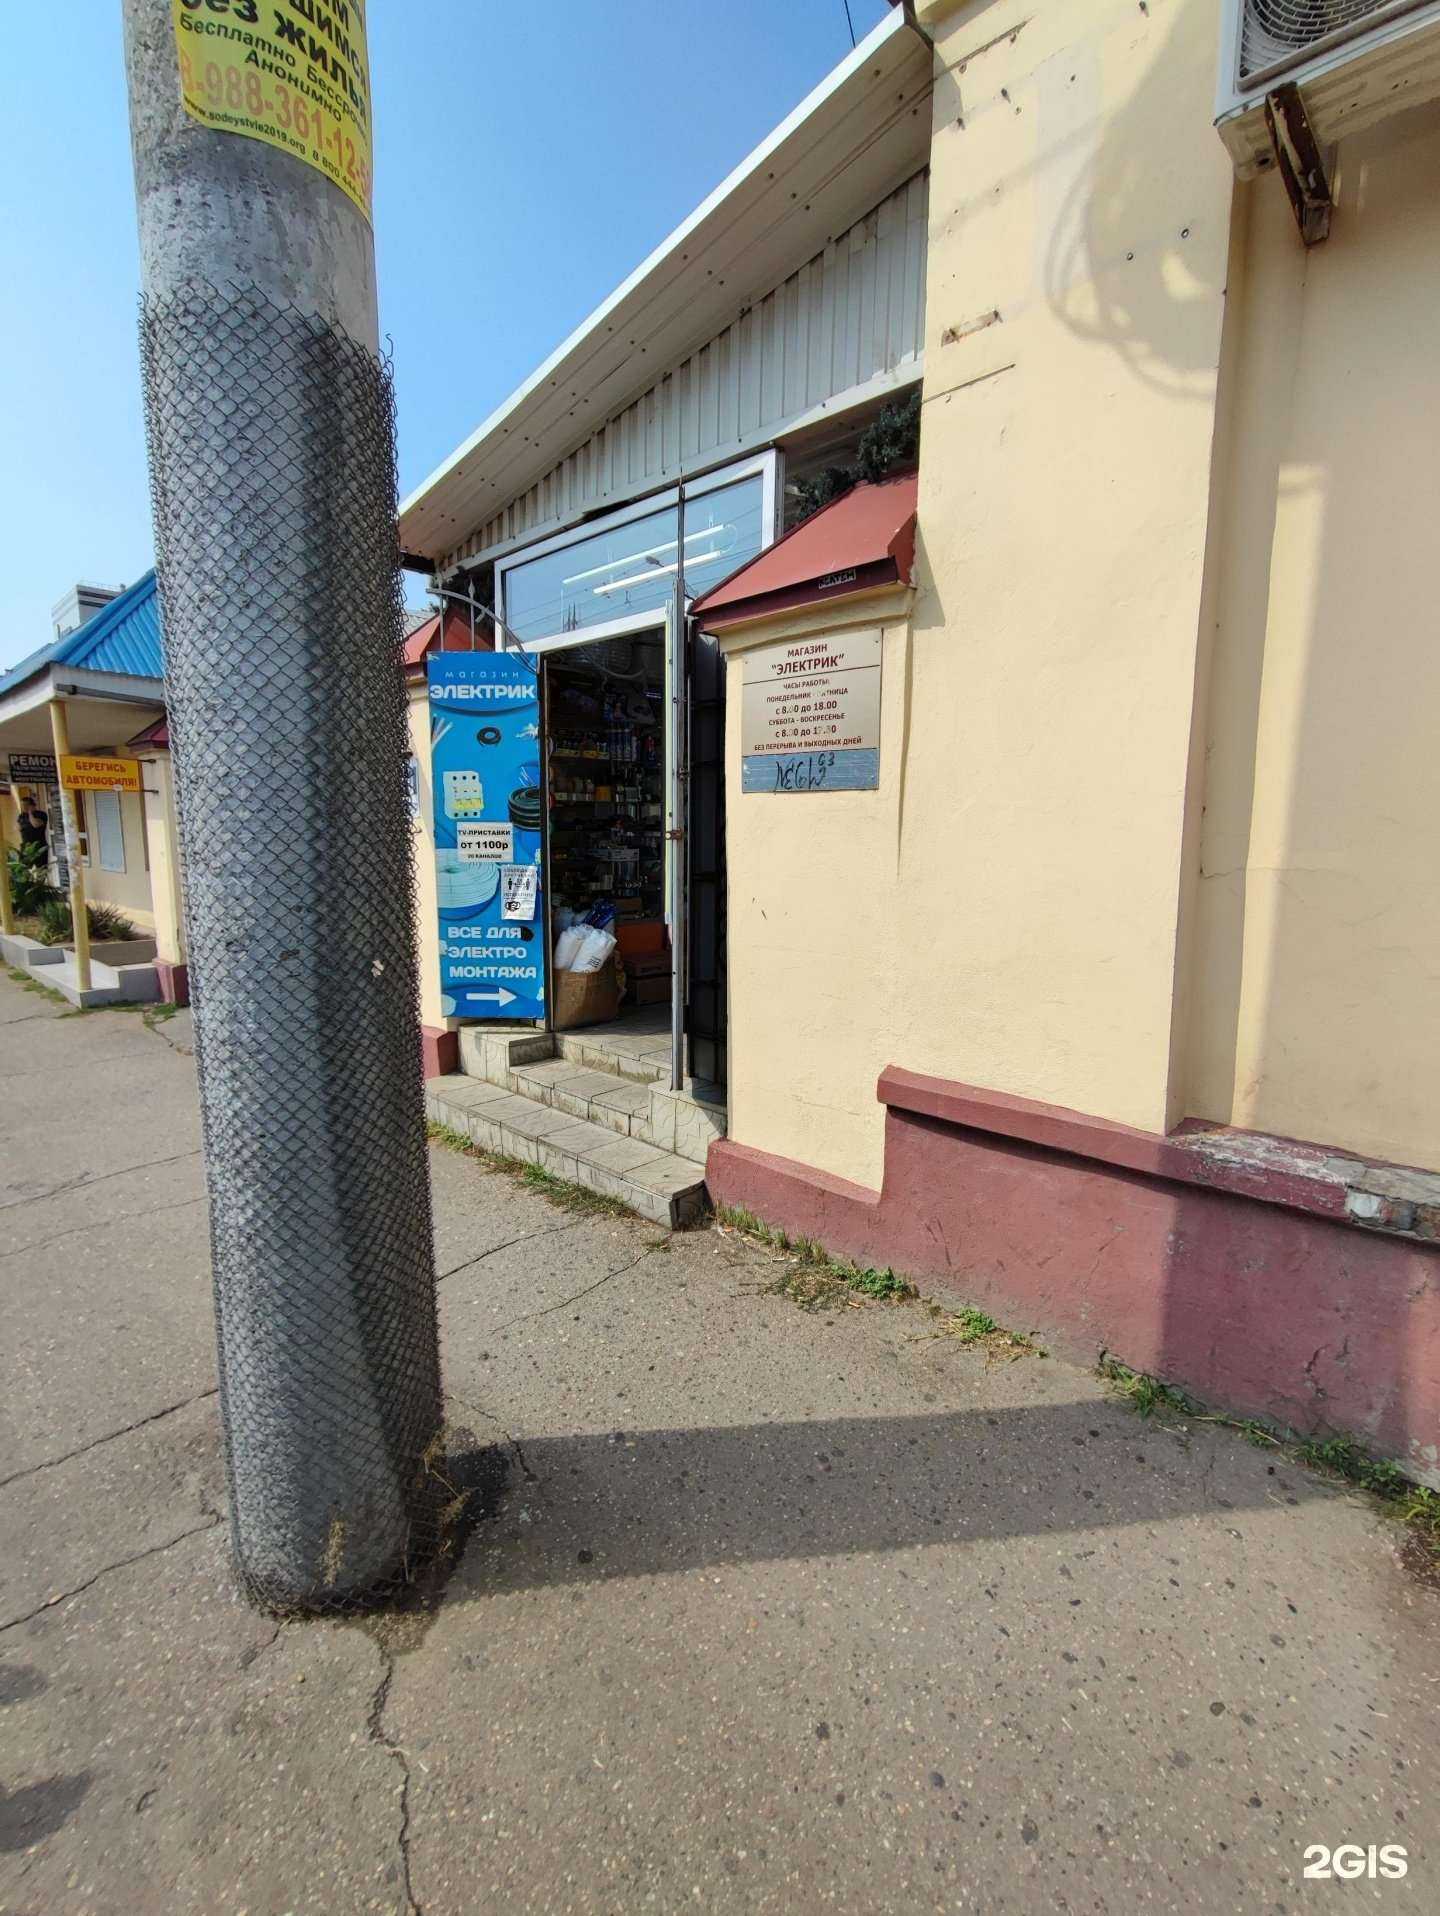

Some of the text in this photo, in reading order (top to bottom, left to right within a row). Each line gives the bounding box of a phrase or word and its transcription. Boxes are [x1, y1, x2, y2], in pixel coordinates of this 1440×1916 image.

[180, 12, 296, 67] Бесплатно
[244, 49, 341, 122] Анонимно
[787, 643, 828, 658] МАГАЗИН
[771, 653, 845, 676] "ЭЛЕКТРИК"
[430, 684, 535, 699] ЭЛЕКТРИК
[783, 681, 801, 690] ЧАСЫ
[766, 692, 811, 703] ПОНЕДЕЛЬНИК
[801, 704, 811, 713] до
[814, 700, 838, 711] 18.00
[768, 717, 795, 726] СУББОТА
[800, 713, 846, 723] ВОСКРЕСЕНЬЕ
[801, 728, 811, 737] до
[754, 743, 765, 751] БЕЗ
[765, 741, 797, 750] ПЕРЕРЫВА
[804, 738, 841, 748] ВЫХОДНЫХ
[843, 735, 862, 746] ДНЕЙ
[75, 760, 126, 773] БЕРЕГИСЬ
[66, 775, 137, 788] АВТОМОБИЛЯ!
[475, 840, 509, 850] 1100р
[447, 926, 522, 939] ВСЕ ДЛЯ
[447, 946, 527, 959] ЭЛЕКТРО
[450, 966, 537, 979] МОНТАЖА
